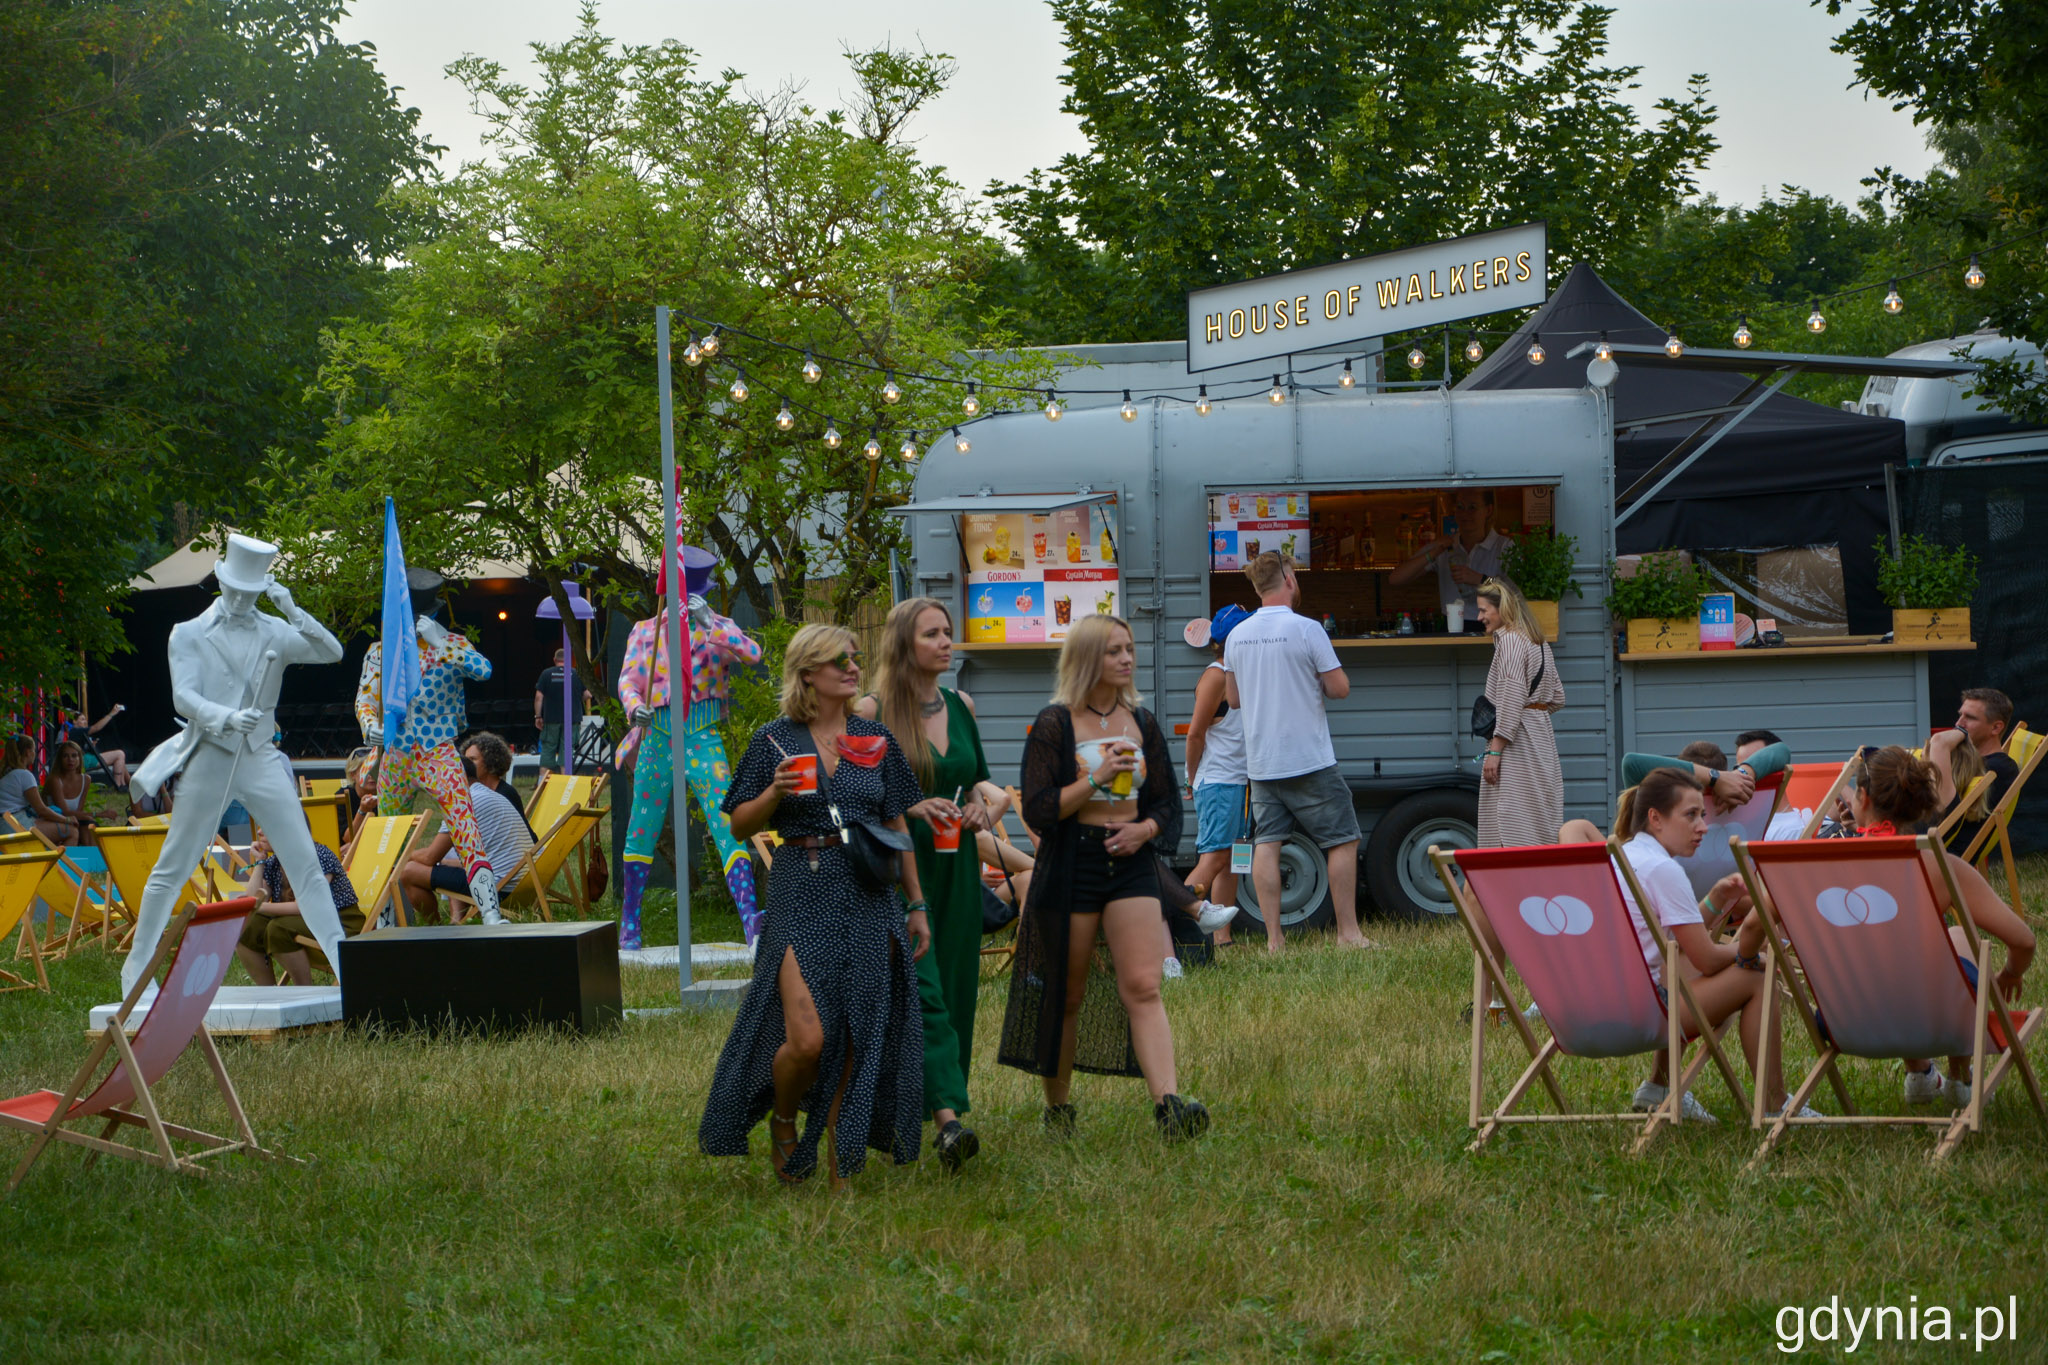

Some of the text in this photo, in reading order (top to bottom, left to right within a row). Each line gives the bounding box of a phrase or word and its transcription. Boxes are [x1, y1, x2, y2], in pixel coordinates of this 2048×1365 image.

[1206, 251, 1532, 344] HOUSE OF WALKERS
[974, 523, 993, 533] TONIC
[987, 571, 1021, 582] GORDON'S
[1065, 569, 1102, 580] Captain Morgan
